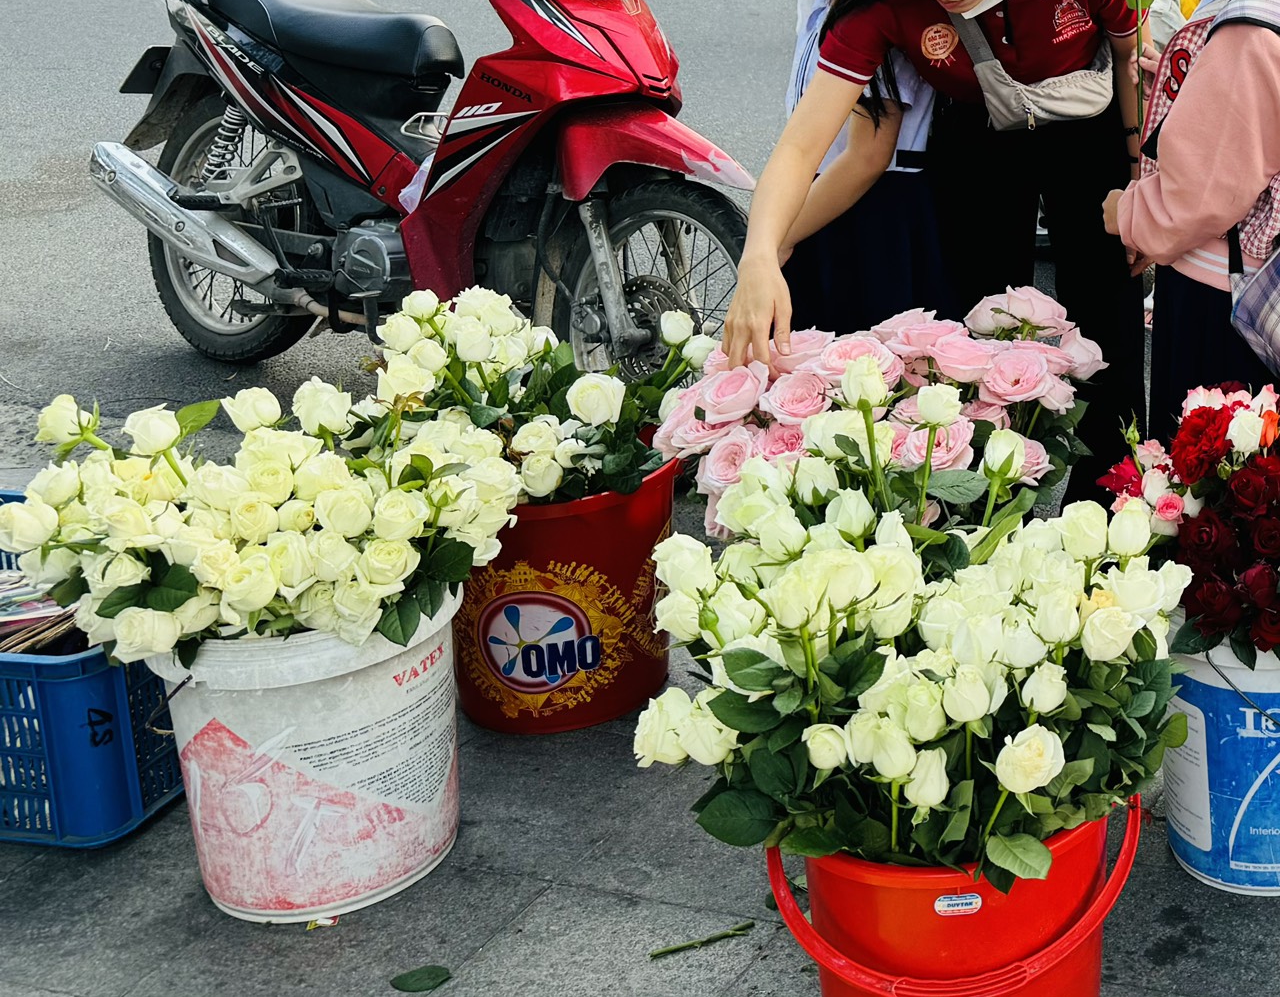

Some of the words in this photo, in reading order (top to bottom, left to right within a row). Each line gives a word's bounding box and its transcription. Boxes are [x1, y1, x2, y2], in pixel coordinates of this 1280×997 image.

[206, 25, 265, 76] BLADE
[480, 72, 534, 103] HONDA
[454, 101, 502, 118] 110
[521, 634, 601, 678] OMO
